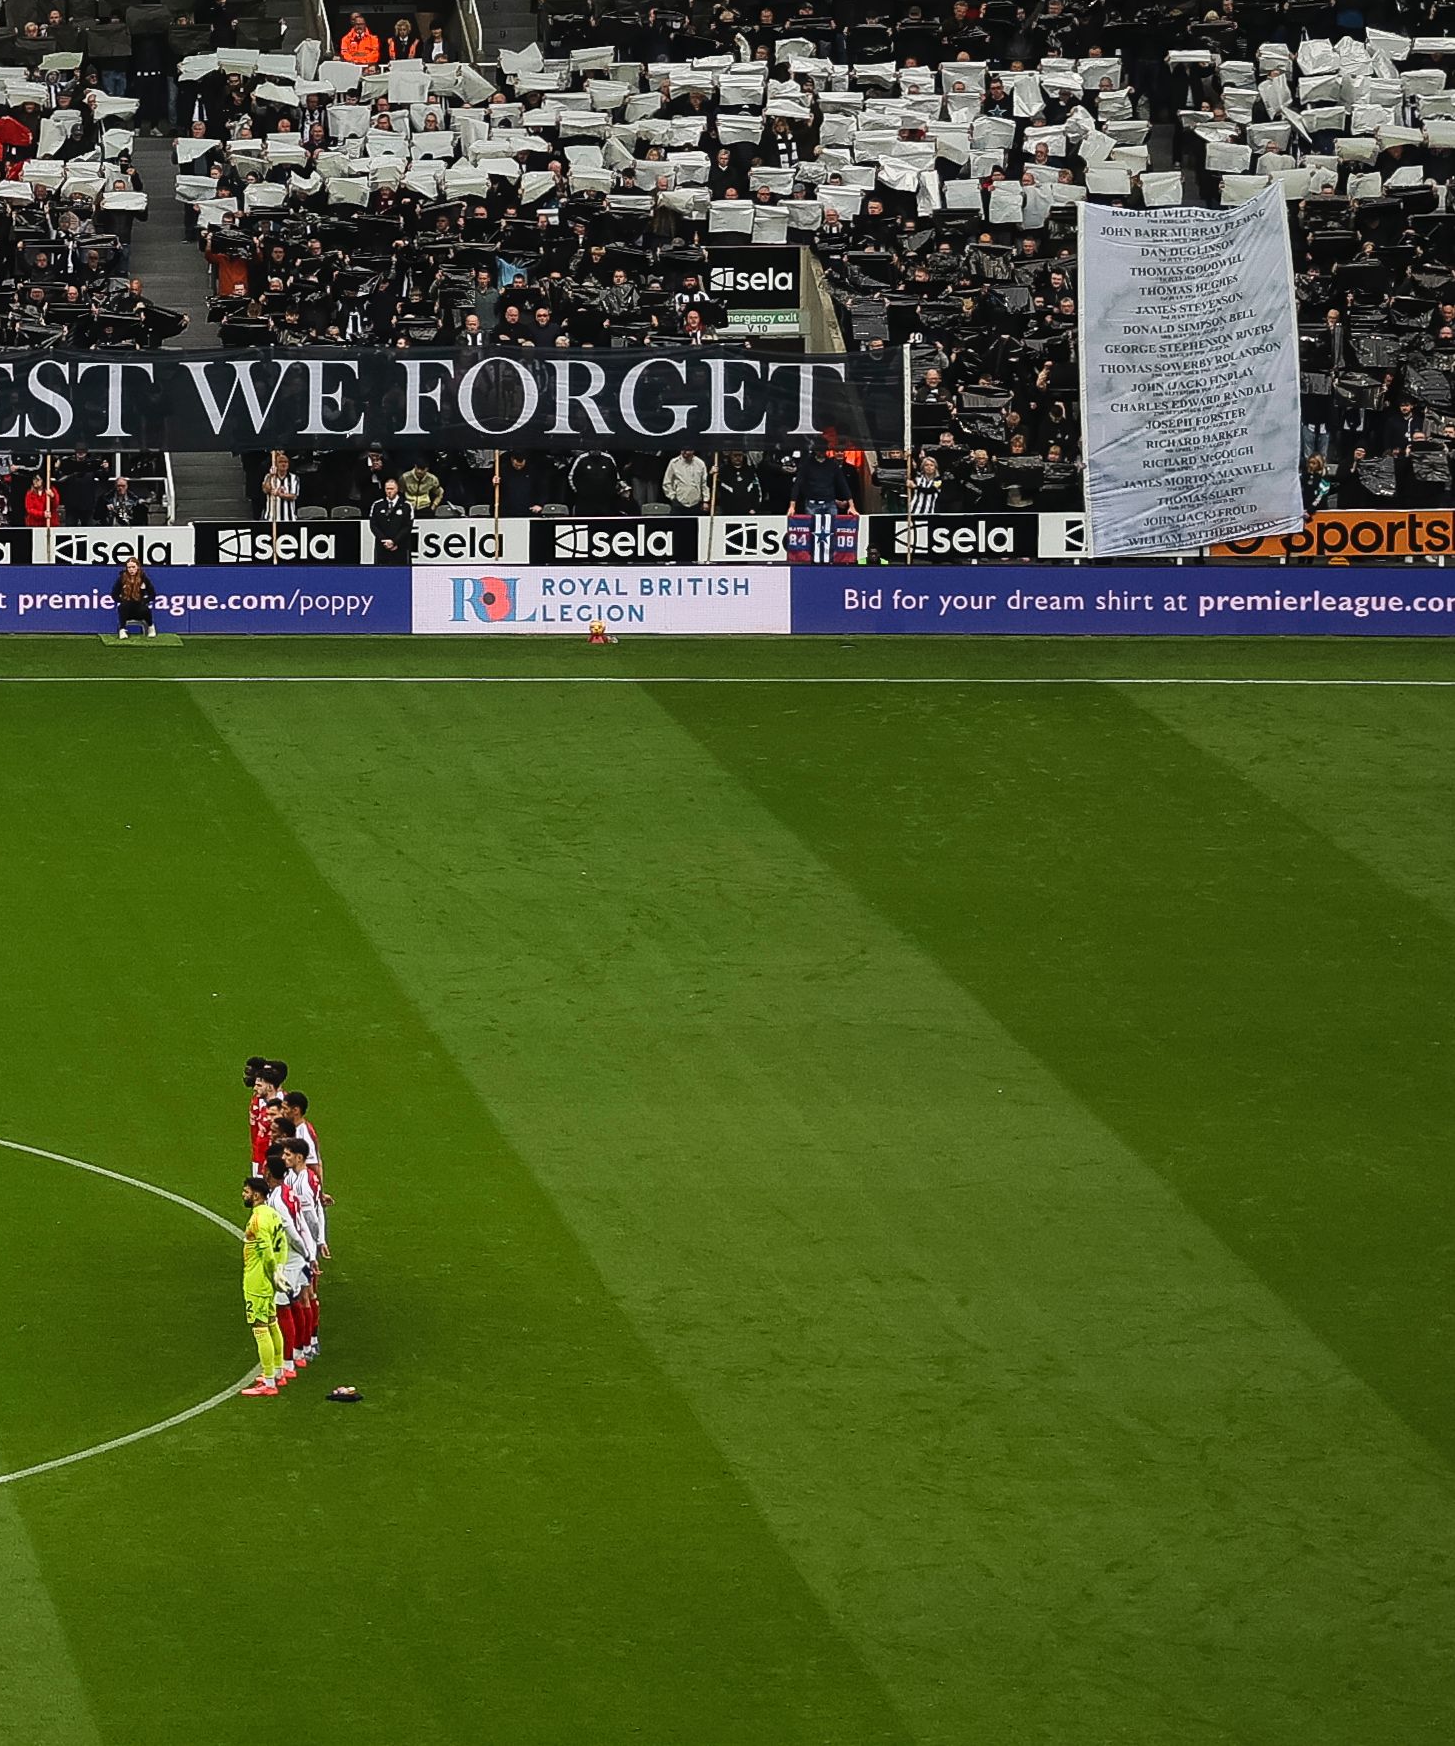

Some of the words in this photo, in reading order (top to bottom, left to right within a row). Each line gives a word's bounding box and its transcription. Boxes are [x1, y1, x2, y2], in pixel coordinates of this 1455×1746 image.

[1100, 227, 1131, 237] JOHN
[1134, 227, 1167, 238] BARR
[1171, 225, 1223, 238] MURRAY
[1141, 247, 1167, 258] DAN
[1130, 266, 1182, 277] THOMAS
[1185, 254, 1246, 276] GOODWILL
[735, 267, 793, 291] sela
[1139, 286, 1192, 297] THOMAS
[1195, 275, 1238, 293] HUGHES
[1135, 304, 1176, 315] JAMES
[1179, 292, 1244, 313] STEVENSON
[727, 313, 775, 324] mergency
[777, 312, 797, 323] exit
[1123, 323, 1174, 335] DONALD
[1177, 315, 1226, 333] SIMPSON
[1229, 308, 1257, 323] BELL
[1104, 343, 1156, 354] GEORGE
[1159, 333, 1233, 353] STEPHENSON
[1235, 323, 1275, 341] RIVERS
[1099, 364, 1152, 374] THOMAS
[1154, 357, 1213, 373] SOWERBY
[1131, 382, 1164, 394] JOHN
[1167, 377, 1207, 391] (JACK)
[1209, 366, 1255, 387] FINDLAY
[178, 361, 366, 438] WE
[393, 353, 849, 438] FORGET
[1110, 401, 1168, 413] CHARLES
[1171, 394, 1220, 408] EDWARD
[1223, 382, 1276, 401] RANDALL
[1145, 417, 1192, 430] JOSEPH
[1195, 408, 1246, 426] FORSTER
[1146, 437, 1197, 449] RICHARD
[1199, 428, 1248, 445] HARKER
[1142, 456, 1197, 469] RICHARD
[1122, 477, 1162, 489] JAMES
[1165, 471, 1215, 486] MORTON
[1217, 462, 1275, 480] MAXWELL
[1157, 494, 1206, 506] THOMAS
[1143, 515, 1172, 527] JOHN
[1219, 504, 1258, 519] FROUD
[91, 536, 172, 564] sela
[254, 531, 336, 560] sela
[421, 528, 503, 557] sela
[591, 524, 673, 557] sela
[931, 523, 1014, 555] sela
[1126, 533, 1183, 547] WILLIAM
[542, 578, 628, 596] ROYAL
[639, 578, 750, 596] BRITISH
[18, 587, 374, 618] premieague.com/poppy
[542, 604, 645, 623] LEGION
[844, 589, 882, 611] Bid
[892, 589, 930, 611] for
[938, 595, 997, 619] your
[1006, 589, 1084, 611] dream
[1095, 589, 1154, 611] shirt
[1164, 593, 1187, 611] at
